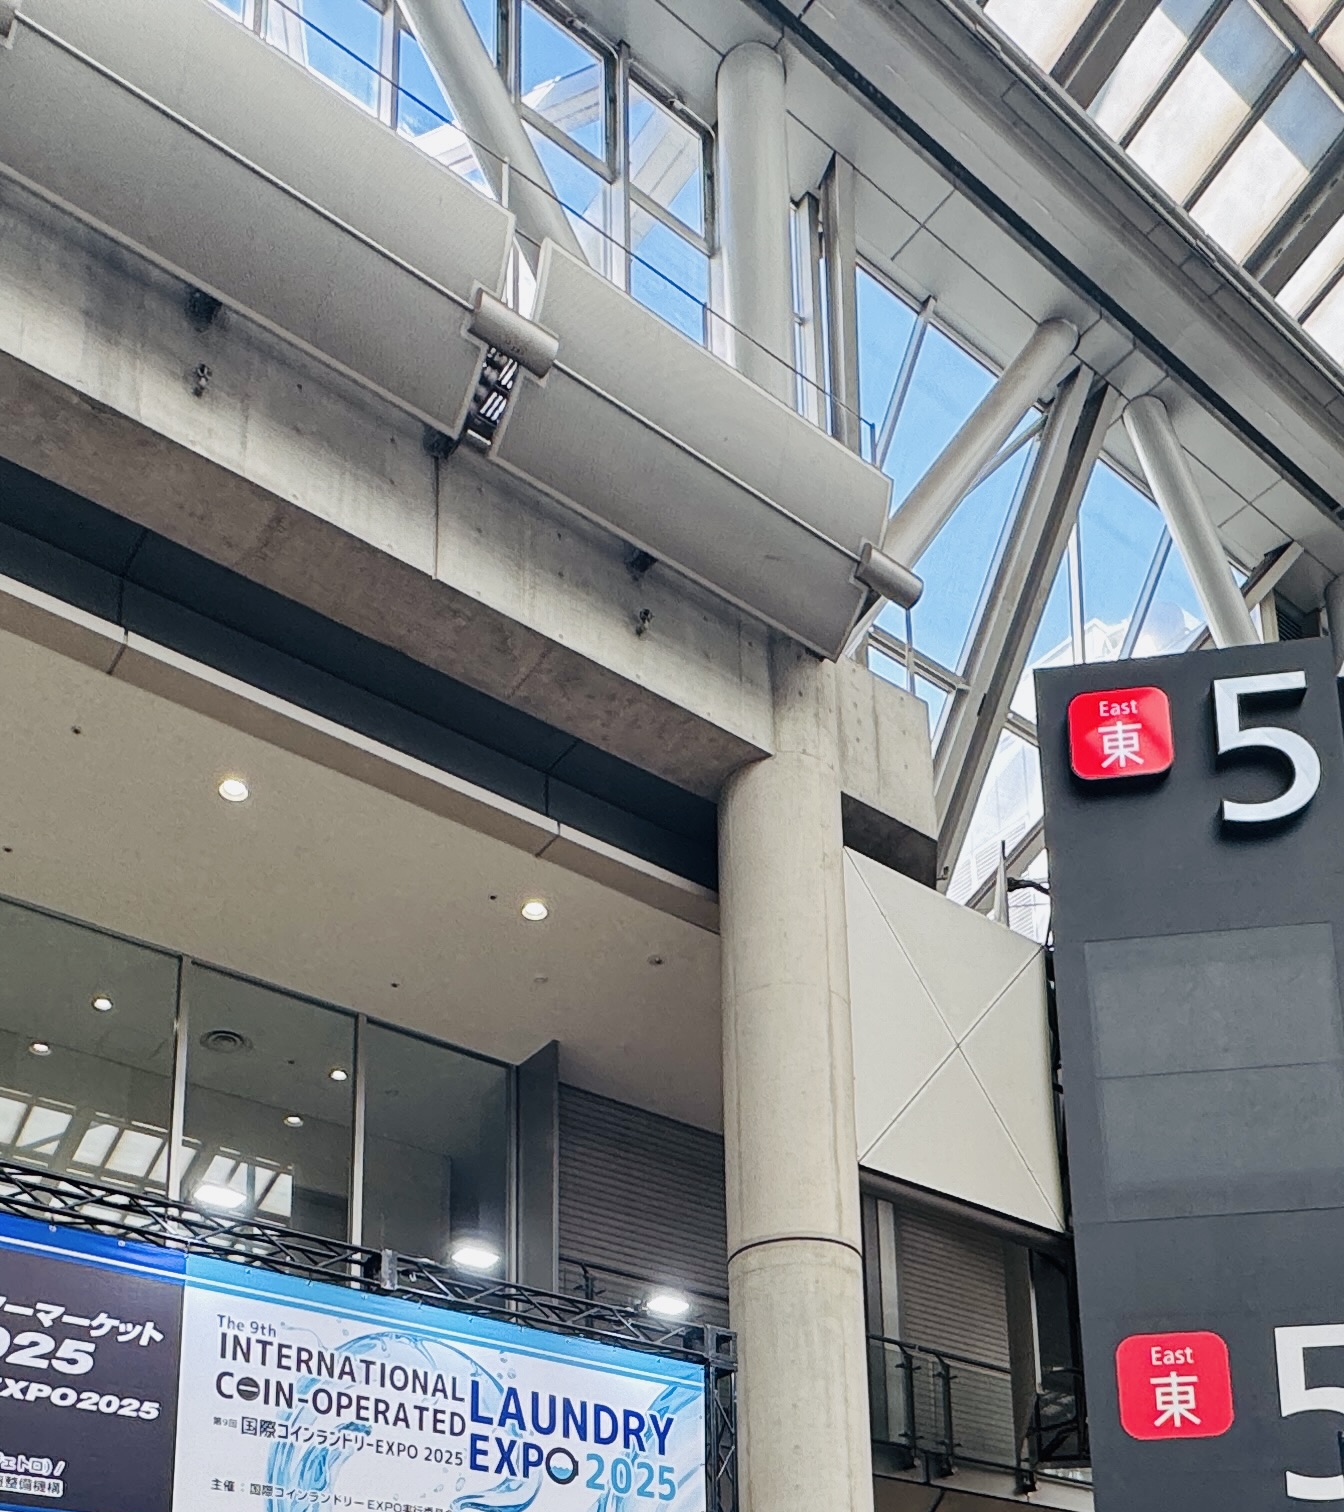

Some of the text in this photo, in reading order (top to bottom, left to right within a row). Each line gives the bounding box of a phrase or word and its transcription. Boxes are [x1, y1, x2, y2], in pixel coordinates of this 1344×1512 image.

[1099, 699, 1138, 717] East
[1098, 721, 1144, 768] 東
[1214, 670, 1321, 822] 5
[217, 1314, 277, 1338] The 9th
[219, 1332, 465, 1402] INTERNATIONAL
[1150, 1346, 1194, 1366] East
[470, 1379, 675, 1456] LAUNDRY
[1150, 1371, 1201, 1428] 東
[424, 1446, 464, 1466] 2025
[469, 1433, 677, 1501] EXPO 2025
